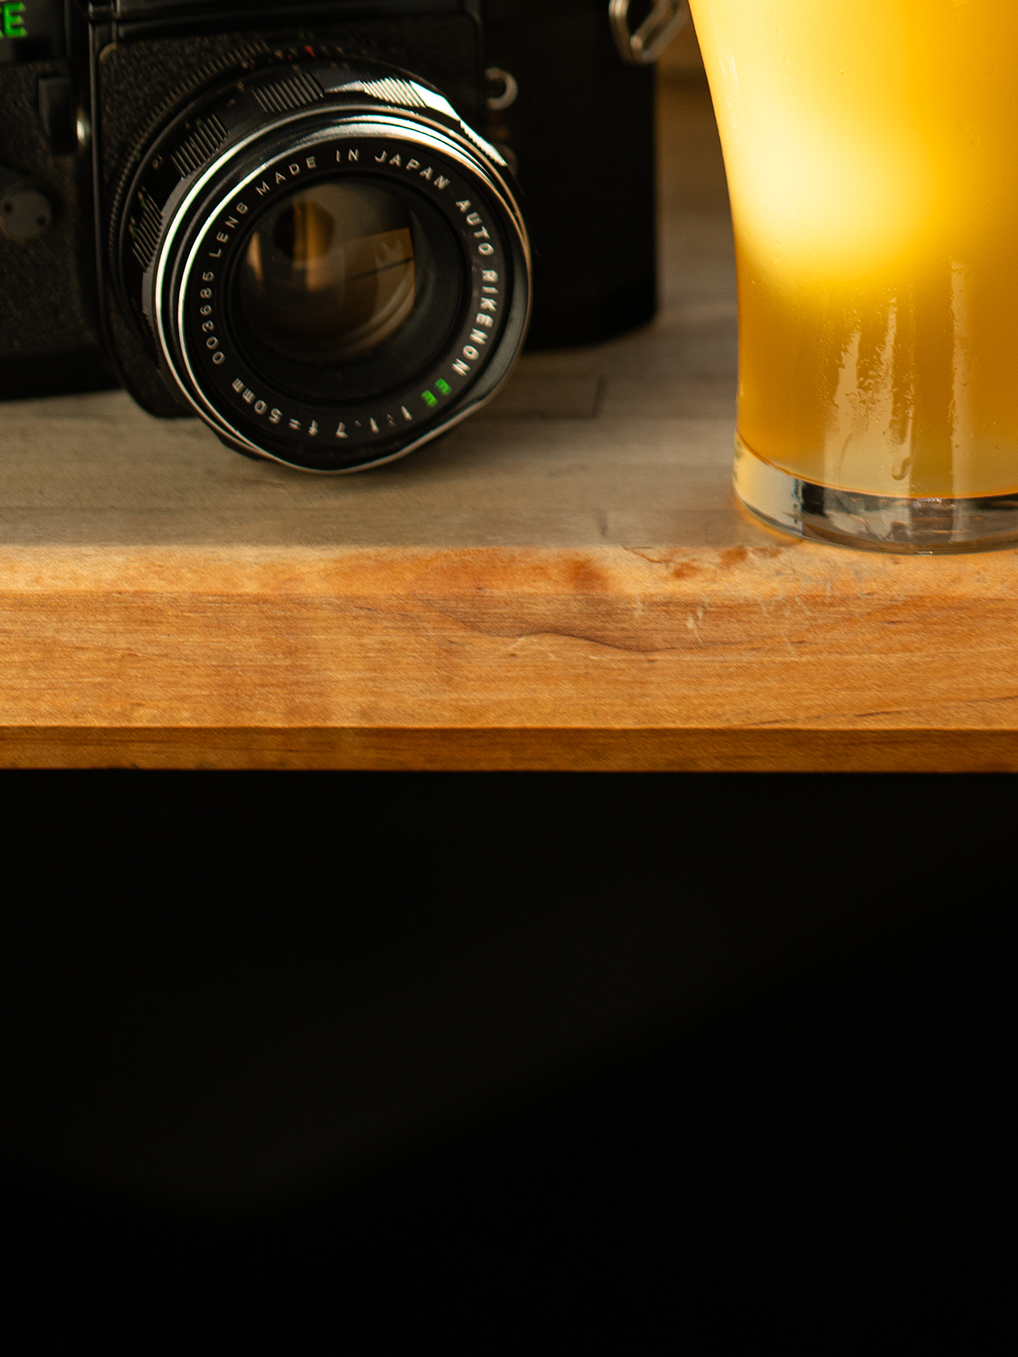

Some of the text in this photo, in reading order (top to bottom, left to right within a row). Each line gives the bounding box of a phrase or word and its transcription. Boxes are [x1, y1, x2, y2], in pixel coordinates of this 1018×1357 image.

[255, 156, 317, 196] MADE
[336, 148, 359, 163] IN
[374, 150, 450, 190] JAPAN
[208, 202, 250, 258] LENS
[454, 199, 495, 256] AUTO
[200, 270, 226, 365] 003685
[452, 269, 499, 377] RIKENON
[420, 378, 452, 408] EE
